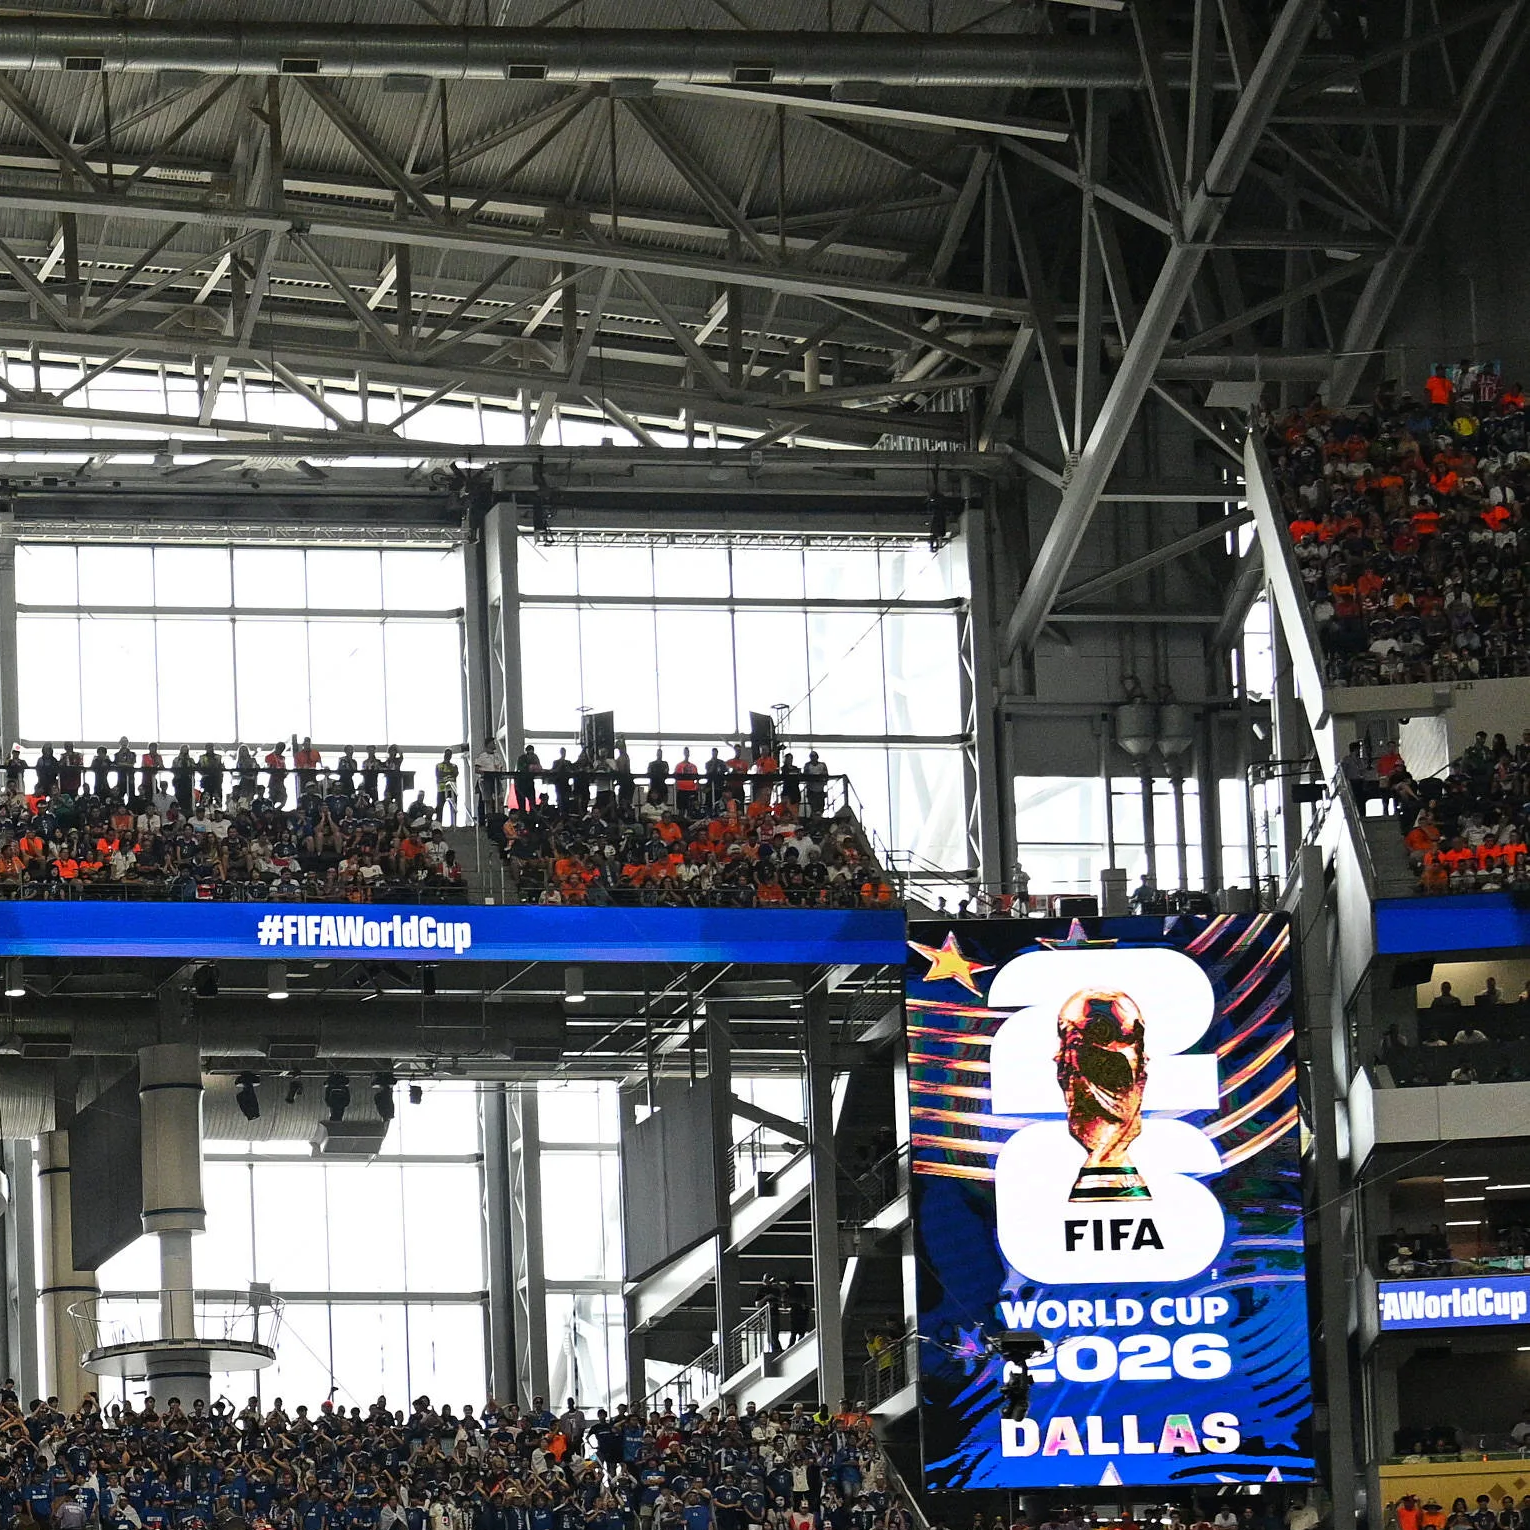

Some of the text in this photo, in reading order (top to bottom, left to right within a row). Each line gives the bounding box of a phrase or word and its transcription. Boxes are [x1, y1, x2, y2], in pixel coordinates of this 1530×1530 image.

[257, 912, 472, 954] #FIFAWorldCup
[1065, 1218, 1164, 1251] FIFA
[1001, 1296, 1228, 1330] WORLD CUP
[1000, 1412, 1241, 1458] DALLAS
